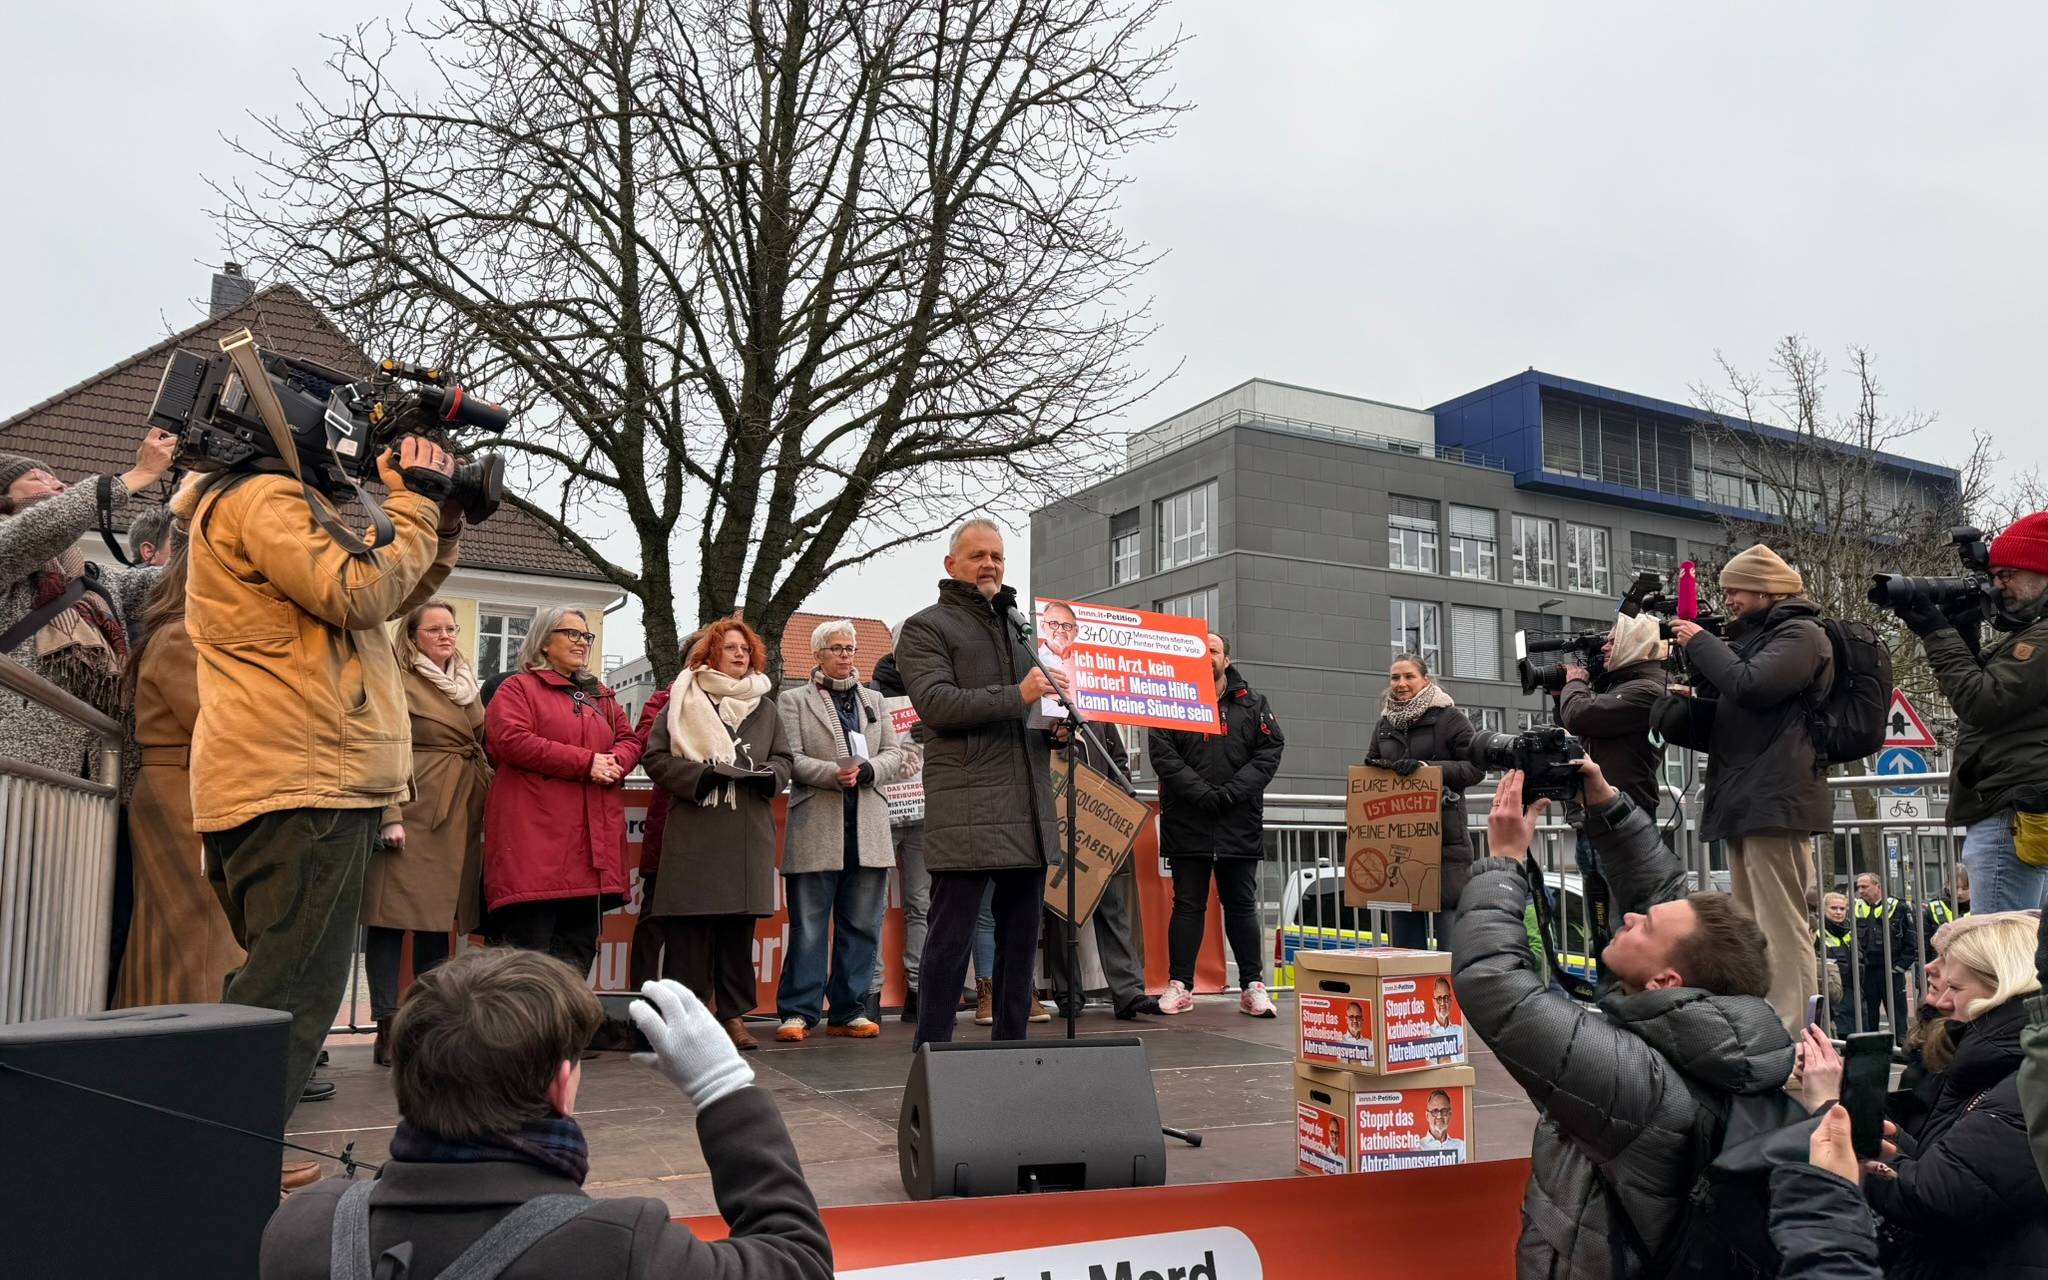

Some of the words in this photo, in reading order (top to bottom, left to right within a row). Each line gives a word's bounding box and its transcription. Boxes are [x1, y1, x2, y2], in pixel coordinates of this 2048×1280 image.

[1133, 631, 1169, 642] Menschen
[1170, 636, 1194, 645] stehen
[1133, 640, 1154, 648] hinter
[1184, 646, 1200, 654] Volz
[1074, 650, 1094, 668] Ich
[1095, 653, 1115, 671] bin
[1118, 655, 1147, 676] Arzt,
[1148, 659, 1175, 678] kein
[1076, 671, 1126, 692] Mörder!
[1129, 676, 1167, 697] Meine
[1168, 681, 1197, 700] Hilfe
[1077, 690, 1109, 711] kann
[1111, 695, 1146, 715] keine
[1147, 699, 1185, 719] Sünde
[1187, 705, 1214, 723] sein
[1351, 778, 1388, 793] EURE
[1392, 778, 1439, 792] MORAL
[889, 808, 915, 816] INIKEN!
[1366, 801, 1386, 817] IST
[1390, 795, 1434, 812] NICHT
[1348, 823, 1386, 840] MEINE
[1388, 821, 1440, 839] MEDIZIN
[1303, 1009, 1325, 1026] Stoppt
[1326, 1012, 1338, 1025] das
[1386, 998, 1411, 1019] Stoppt
[1411, 997, 1425, 1015] das
[1303, 1024, 1342, 1041] katholische
[1386, 1018, 1430, 1040] katholische
[1304, 1040, 1368, 1060] Abtreibungsverbot
[1388, 1037, 1458, 1063] Abtreibungsverbot
[1360, 1109, 1394, 1131] Stoppt
[1395, 1108, 1414, 1127] das
[1360, 1130, 1420, 1151] katholische
[1361, 1151, 1457, 1174] Abtreibungsverbot
